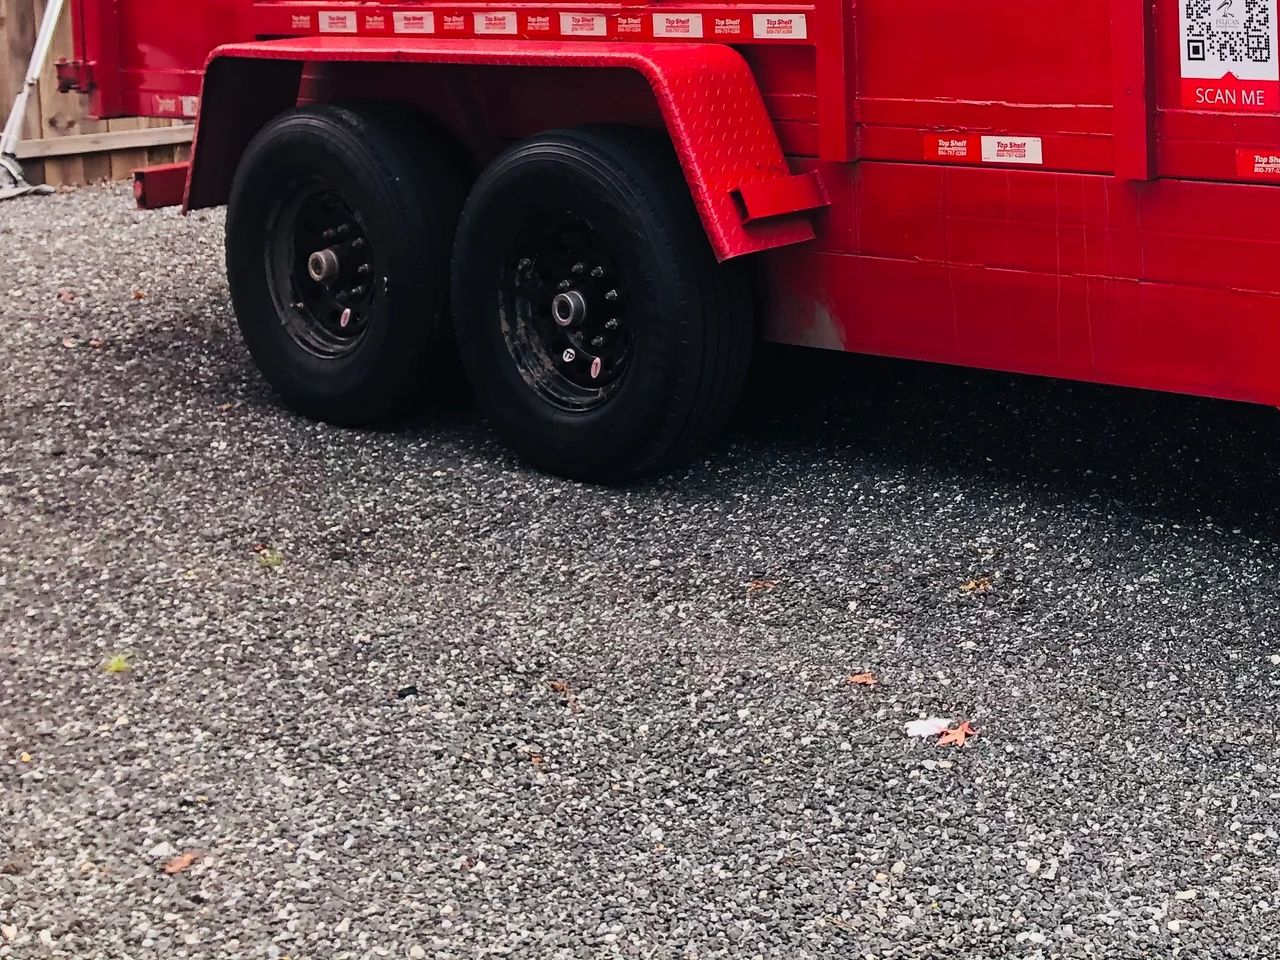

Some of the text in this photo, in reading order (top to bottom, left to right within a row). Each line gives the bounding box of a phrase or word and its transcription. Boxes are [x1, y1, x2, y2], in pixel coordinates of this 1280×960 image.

[1196, 88, 1265, 106] SCAN ME
[938, 140, 949, 148] Top
[997, 142, 1008, 150] Top
[1254, 155, 1268, 164] Top
